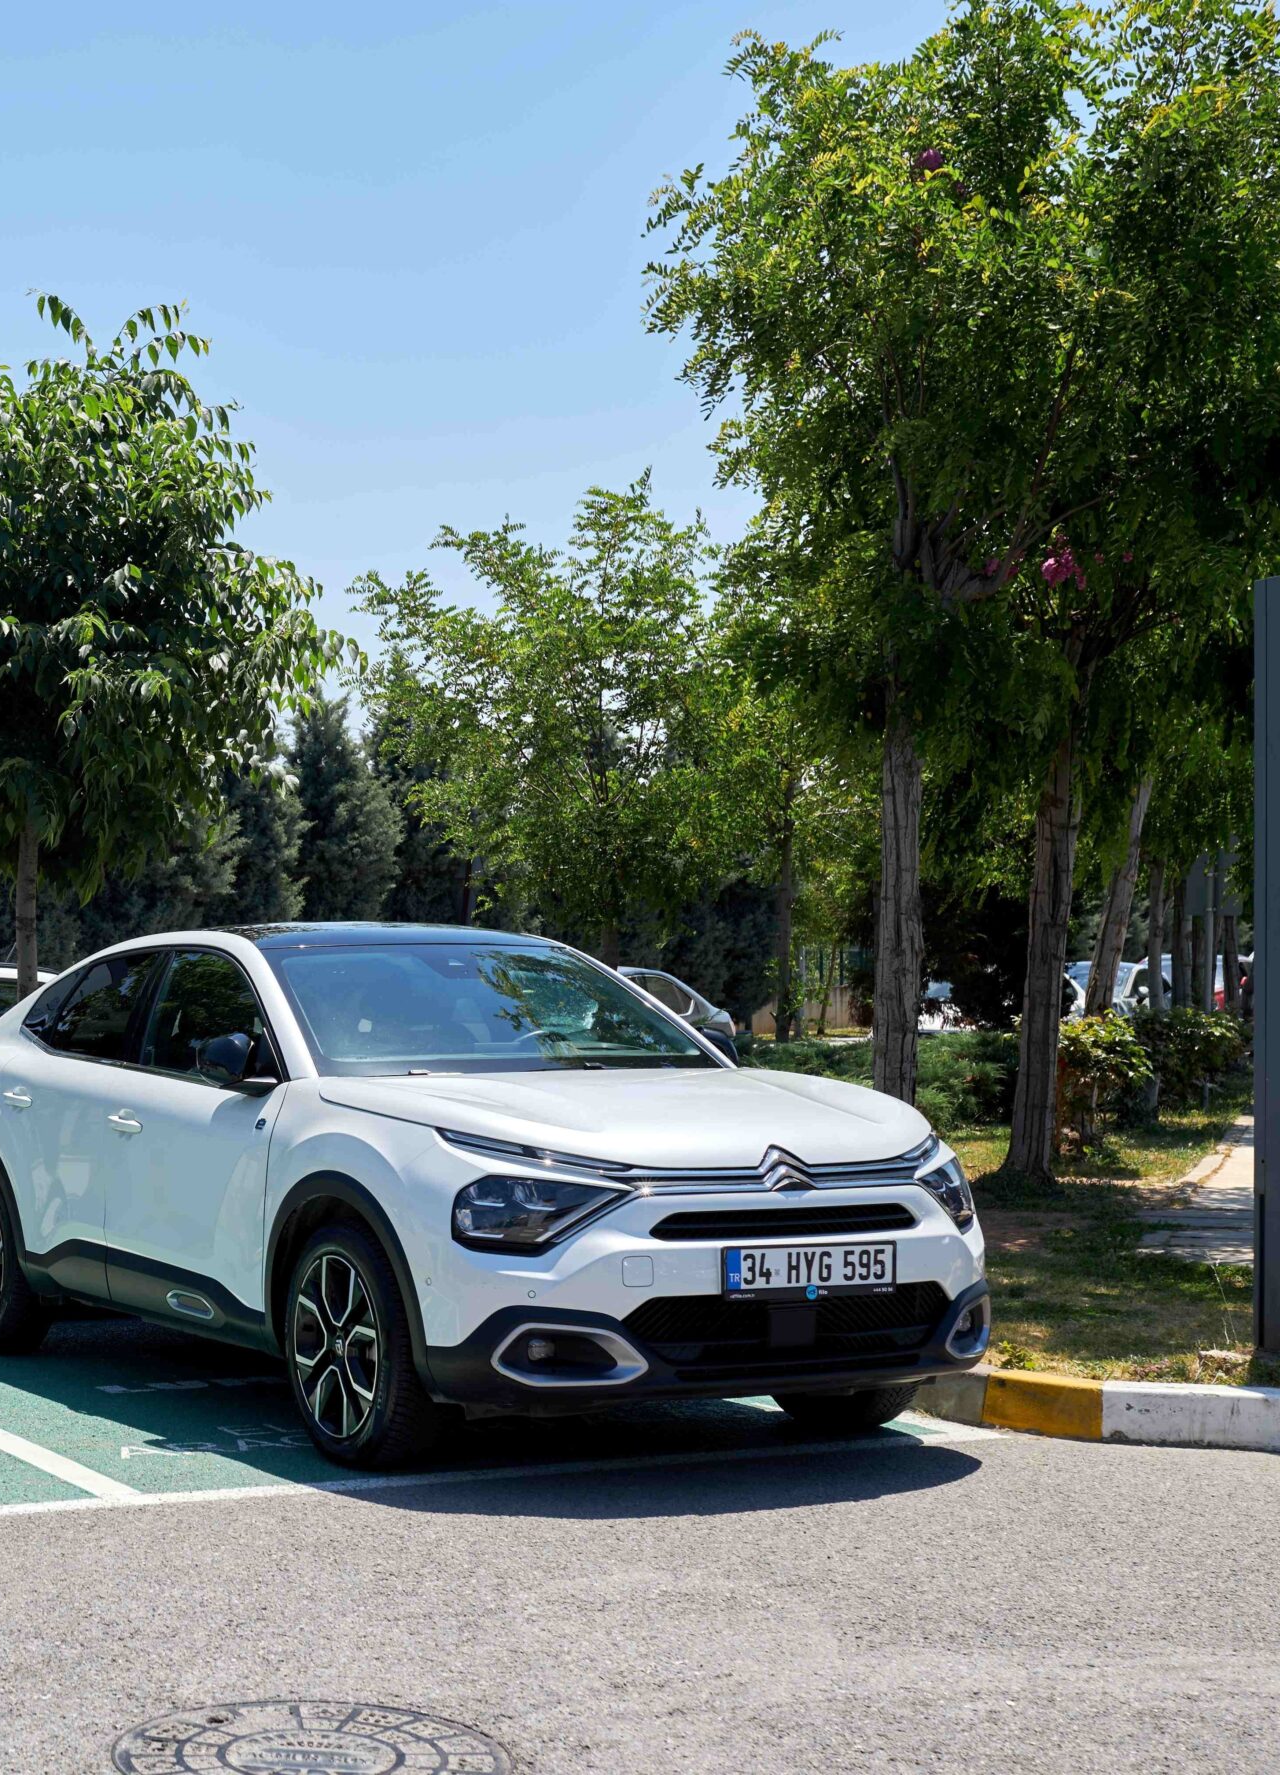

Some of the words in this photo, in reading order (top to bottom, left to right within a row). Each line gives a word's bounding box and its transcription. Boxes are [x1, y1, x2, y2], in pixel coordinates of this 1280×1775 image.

[729, 1273, 740, 1283] TR
[742, 1253, 773, 1286] 34
[787, 1250, 832, 1284] HYG
[843, 1249, 885, 1281] 595
